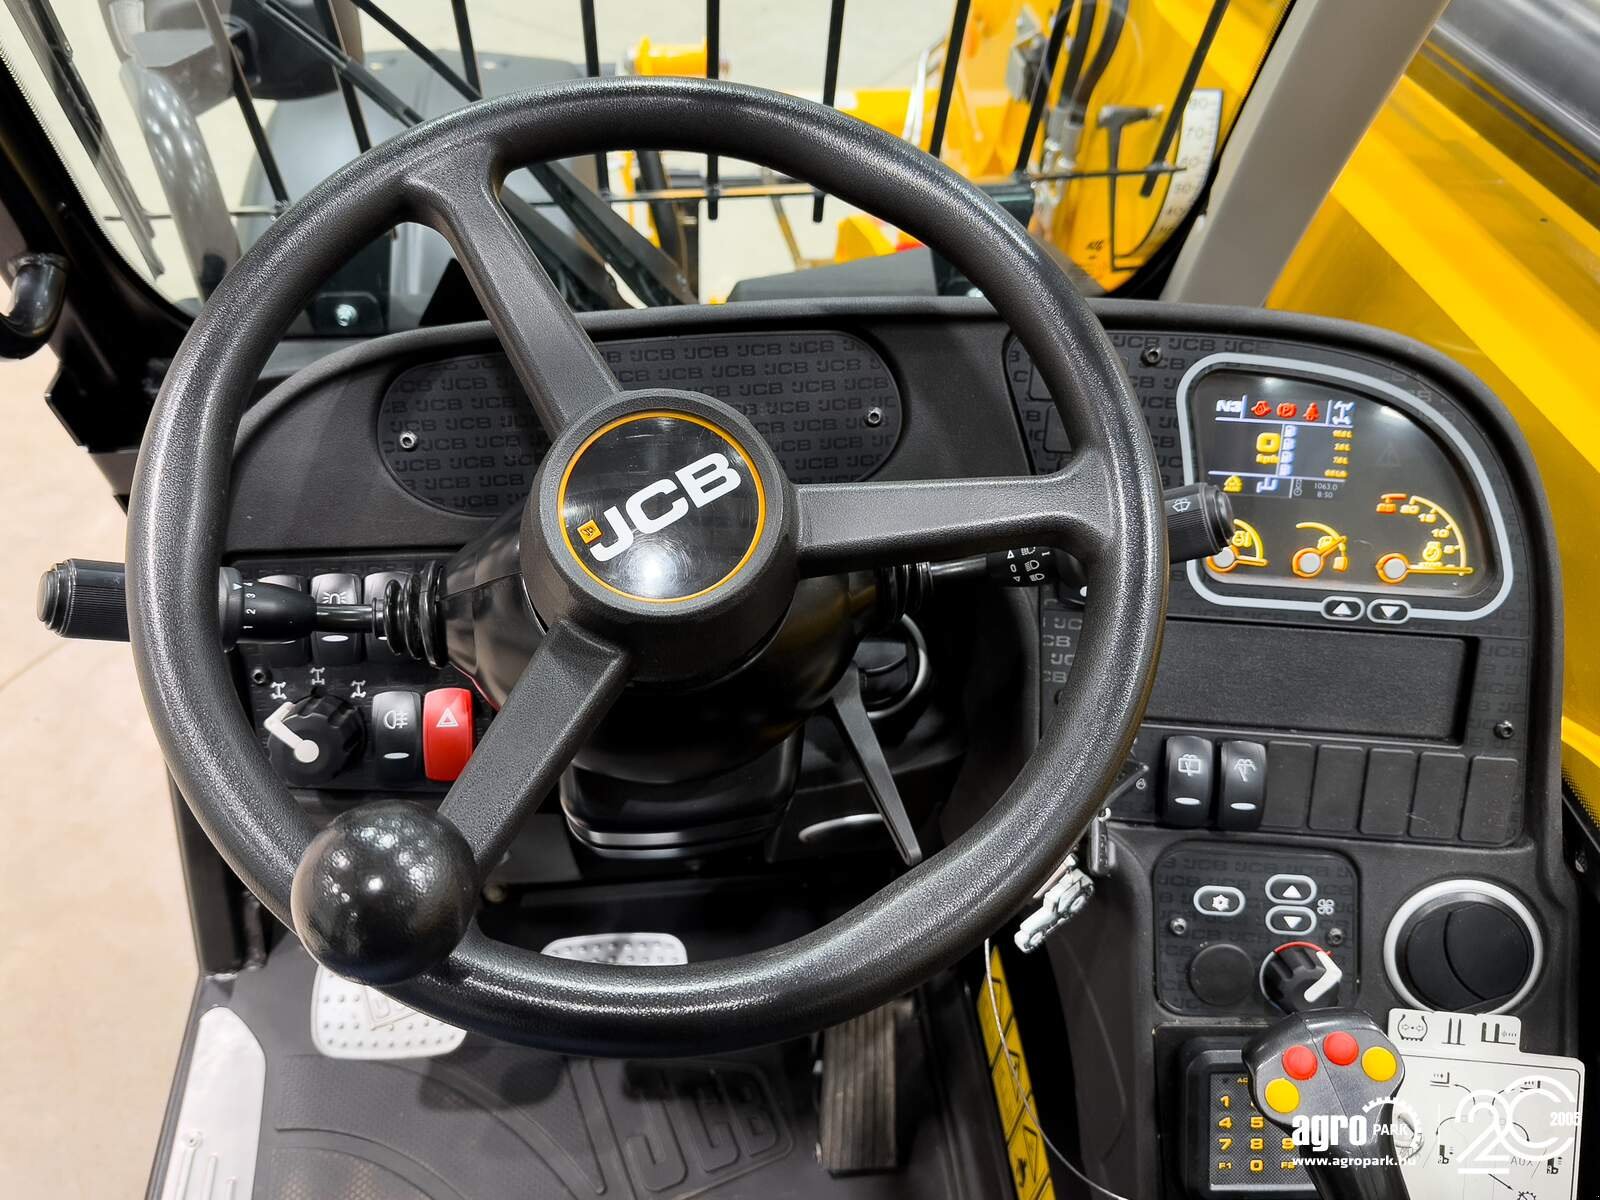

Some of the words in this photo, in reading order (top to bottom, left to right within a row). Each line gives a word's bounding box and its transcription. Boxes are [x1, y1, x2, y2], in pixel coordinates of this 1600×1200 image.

[1314, 482, 1338, 491] 1063.0
[589, 453, 741, 561] JCB
[1431, 528, 1450, 539] 10
[1054, 616, 1083, 630] JC
[1220, 1095, 1231, 1108] 1
[1218, 1116, 1233, 1129] 4
[1250, 1116, 1264, 1129] 5
[1218, 1138, 1233, 1151] 7
[1250, 1138, 1264, 1150] 8
[1281, 1137, 1296, 1150] 9
[1218, 1161, 1232, 1169] F1
[1250, 1159, 1264, 1172] 0
